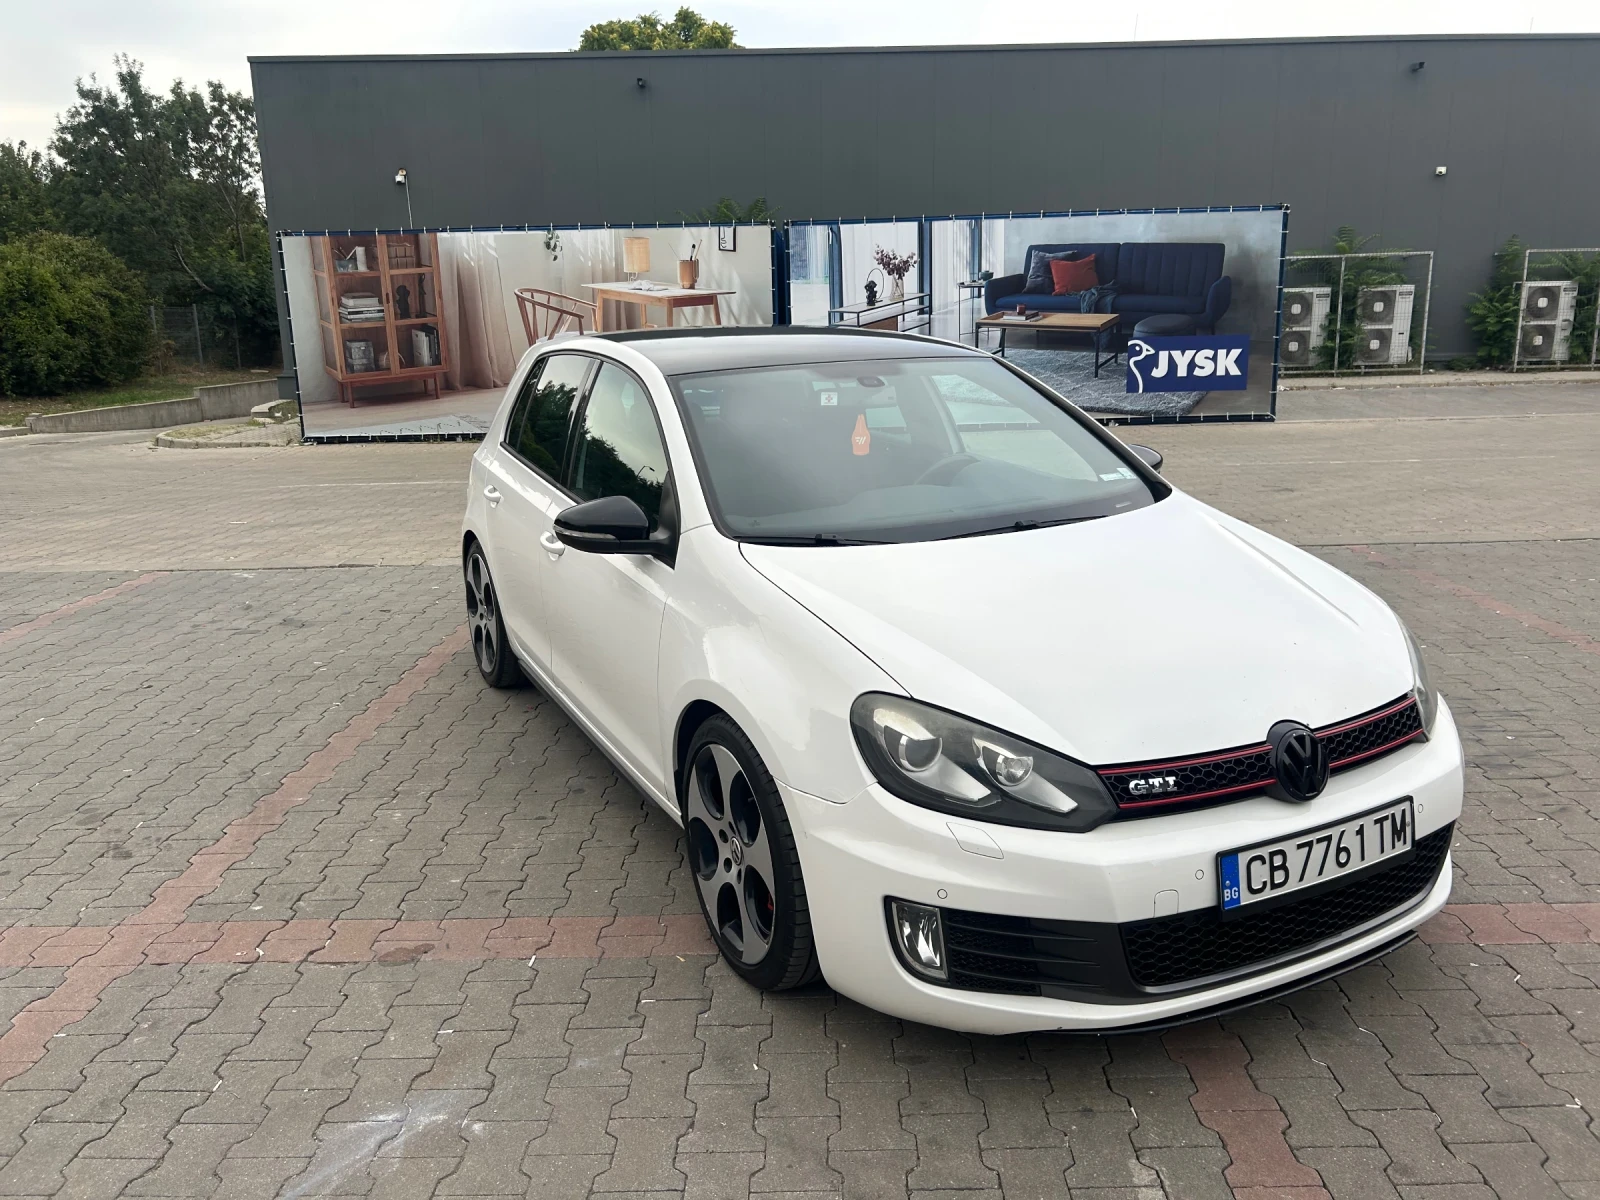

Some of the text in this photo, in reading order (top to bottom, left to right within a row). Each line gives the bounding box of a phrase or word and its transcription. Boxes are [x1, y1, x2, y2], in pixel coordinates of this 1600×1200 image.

[1150, 348, 1243, 378] JYSK
[1128, 776, 1178, 796] GTI
[1246, 807, 1408, 895] CB 7761 TM
[1223, 886, 1239, 901] BG
